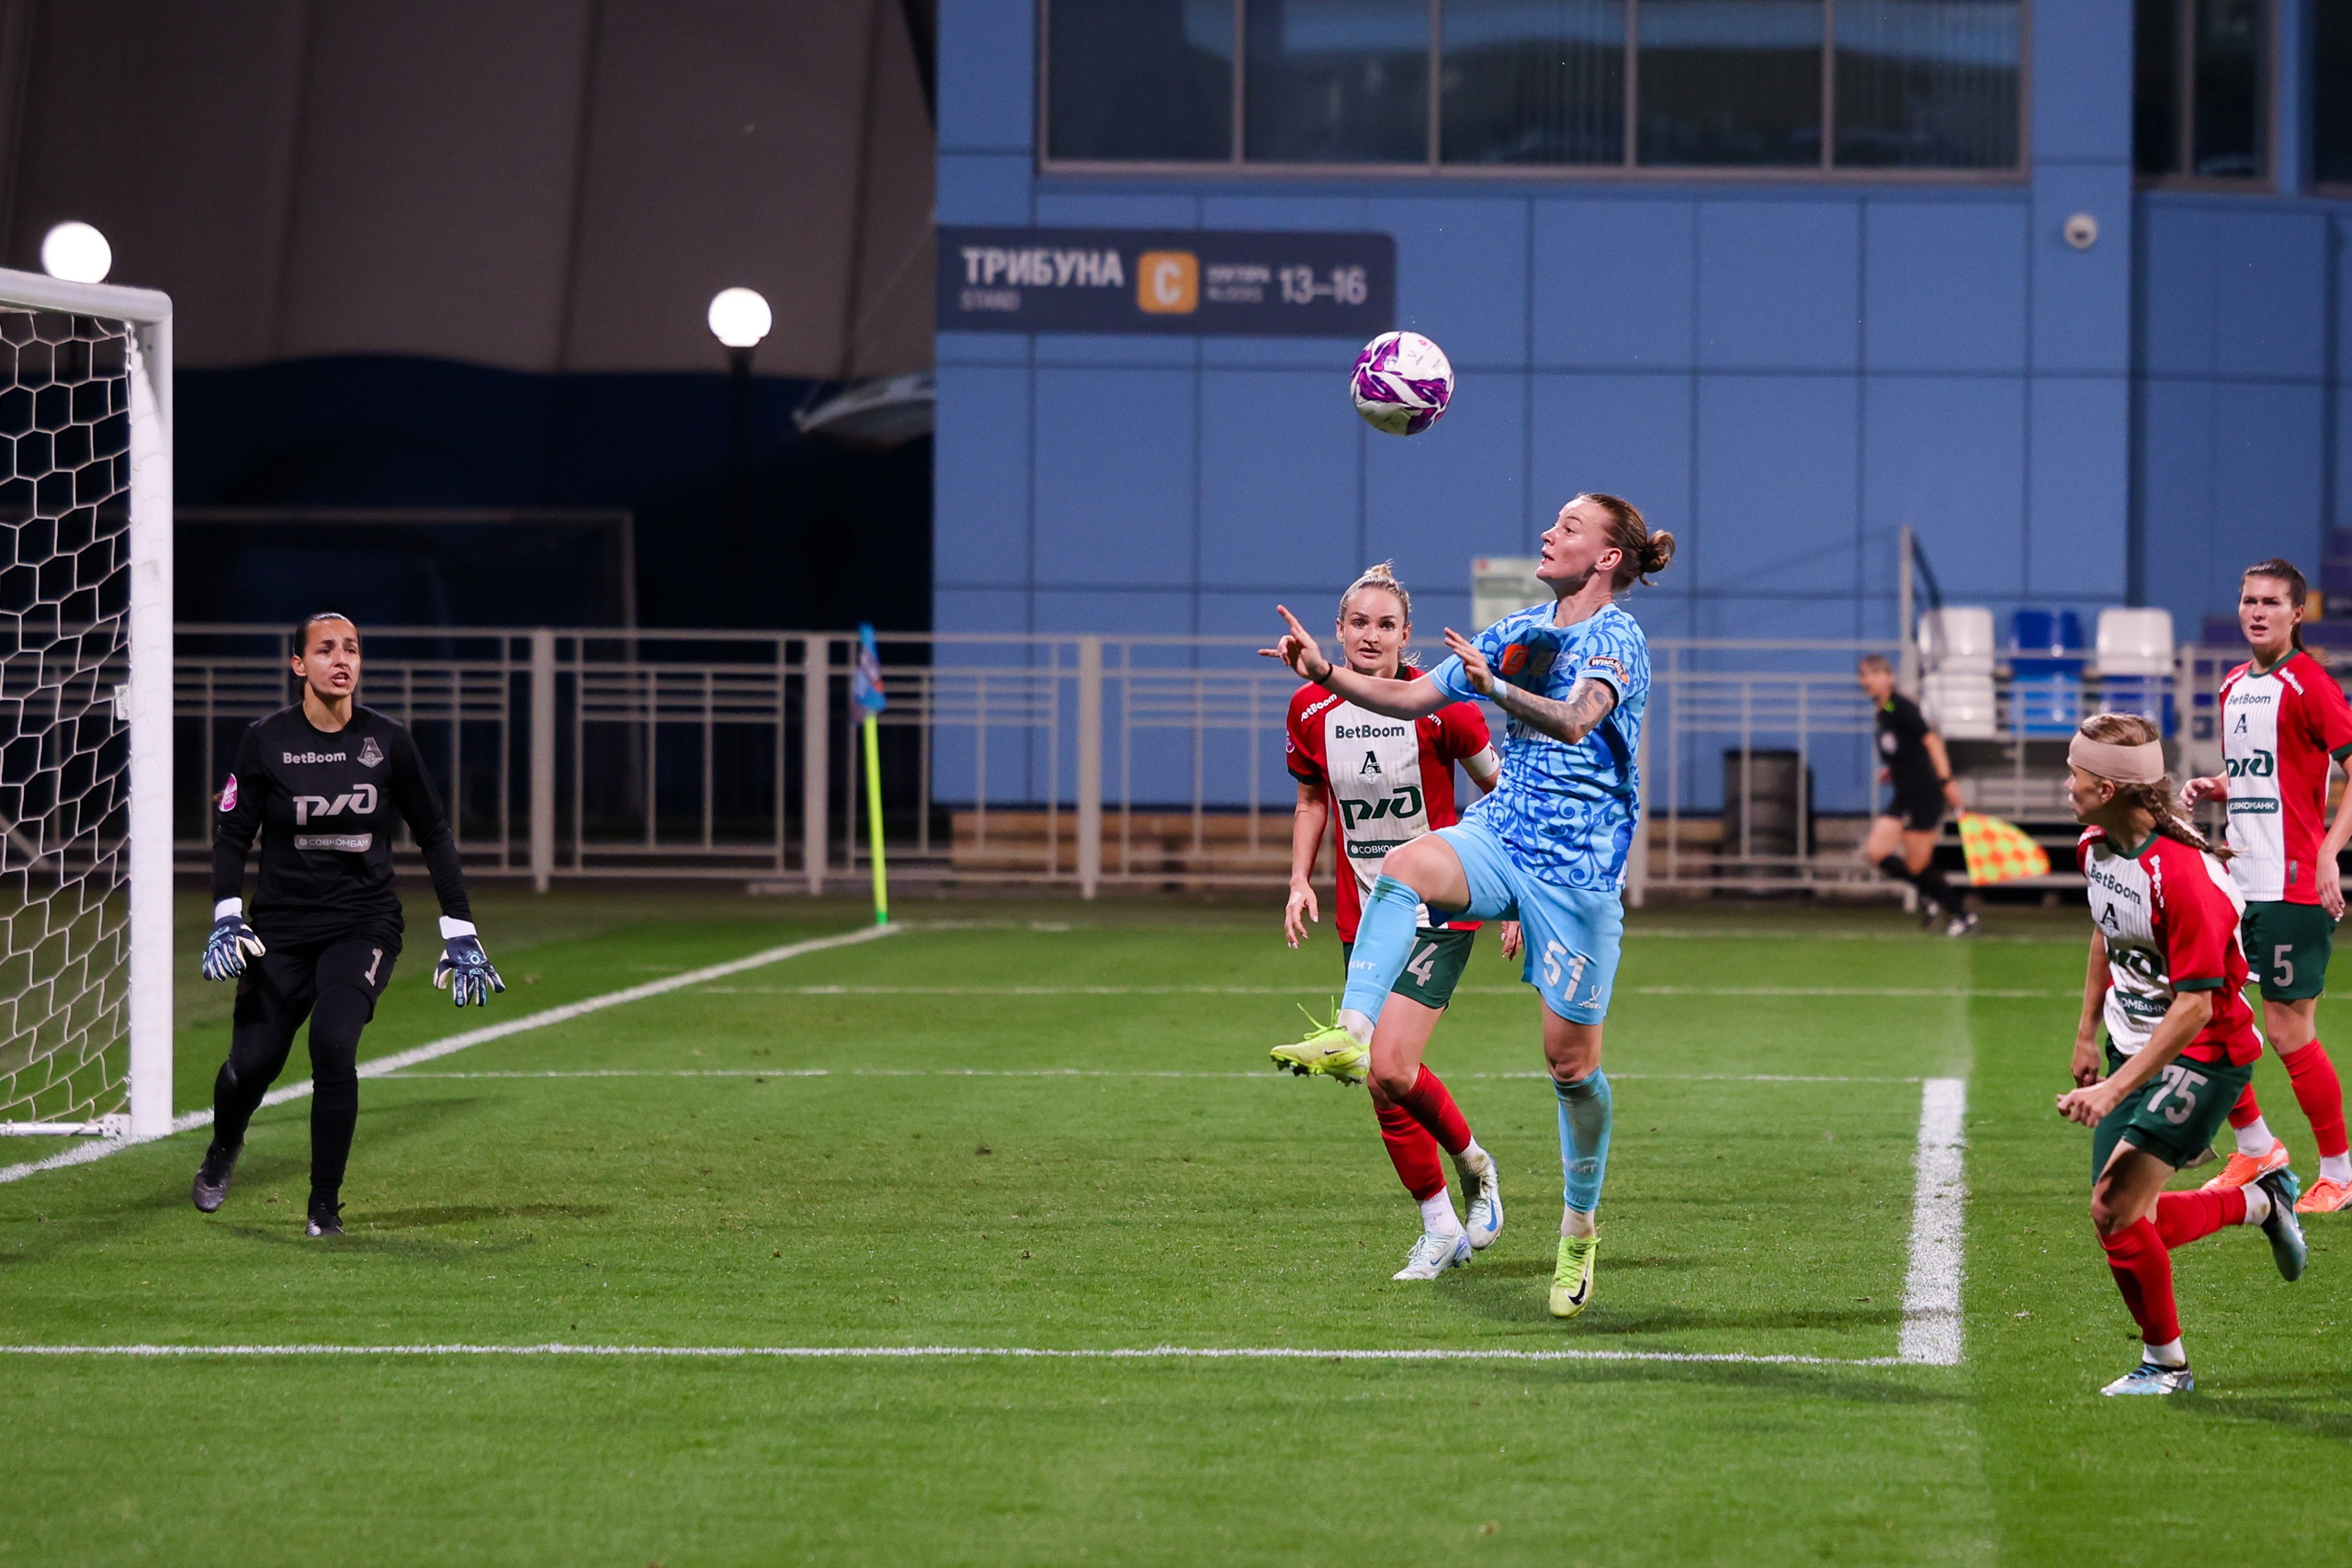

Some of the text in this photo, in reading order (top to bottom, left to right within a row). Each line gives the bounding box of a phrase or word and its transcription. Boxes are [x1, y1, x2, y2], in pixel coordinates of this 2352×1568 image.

[962, 248, 1125, 288] ТРИБУНА
[2278, 667, 2304, 695] BetBoom
[1301, 694, 1338, 722] etBoom
[2227, 694, 2271, 705] BetBoom
[1335, 724, 1405, 739] BetBoom
[283, 751, 347, 764] BetBoom
[2229, 801, 2275, 810] ОВКОМБАНК
[1358, 844, 1394, 854] СОВКО
[2089, 863, 2142, 906] BetBoom
[365, 948, 383, 987] 1
[1407, 937, 1439, 987] 4
[1544, 940, 1587, 1002] 51
[2273, 944, 2294, 987] 5
[2120, 997, 2166, 1013] ОМБАНК
[2146, 1065, 2209, 1125] 75
